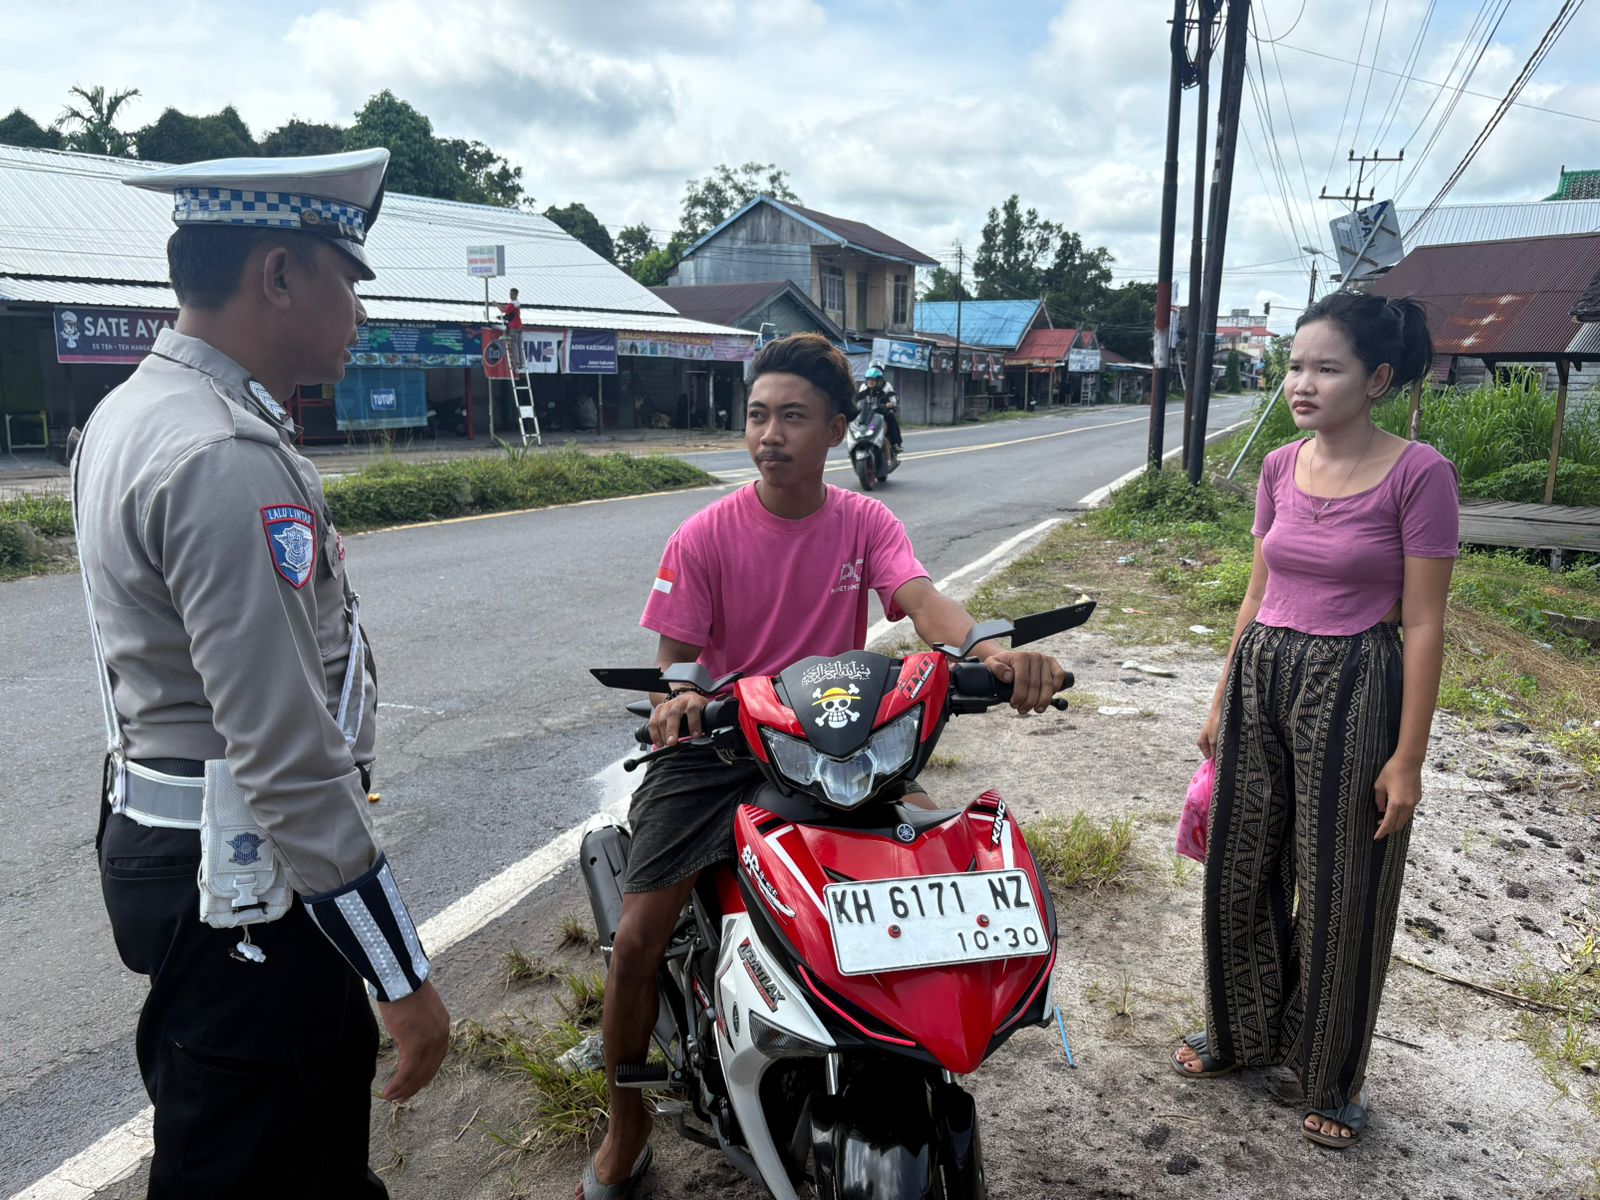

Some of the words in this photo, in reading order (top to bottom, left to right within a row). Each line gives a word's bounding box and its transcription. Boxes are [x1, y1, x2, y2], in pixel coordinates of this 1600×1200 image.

[84, 316, 130, 337] SATE
[135, 318, 178, 338] AYA
[373, 393, 394, 405] TUTUP
[268, 507, 287, 520] LALU
[289, 508, 312, 523] LINTAS
[991, 799, 1006, 845] KING
[831, 889, 876, 924] KH
[888, 880, 965, 919] 6171
[988, 875, 1030, 910] NZ
